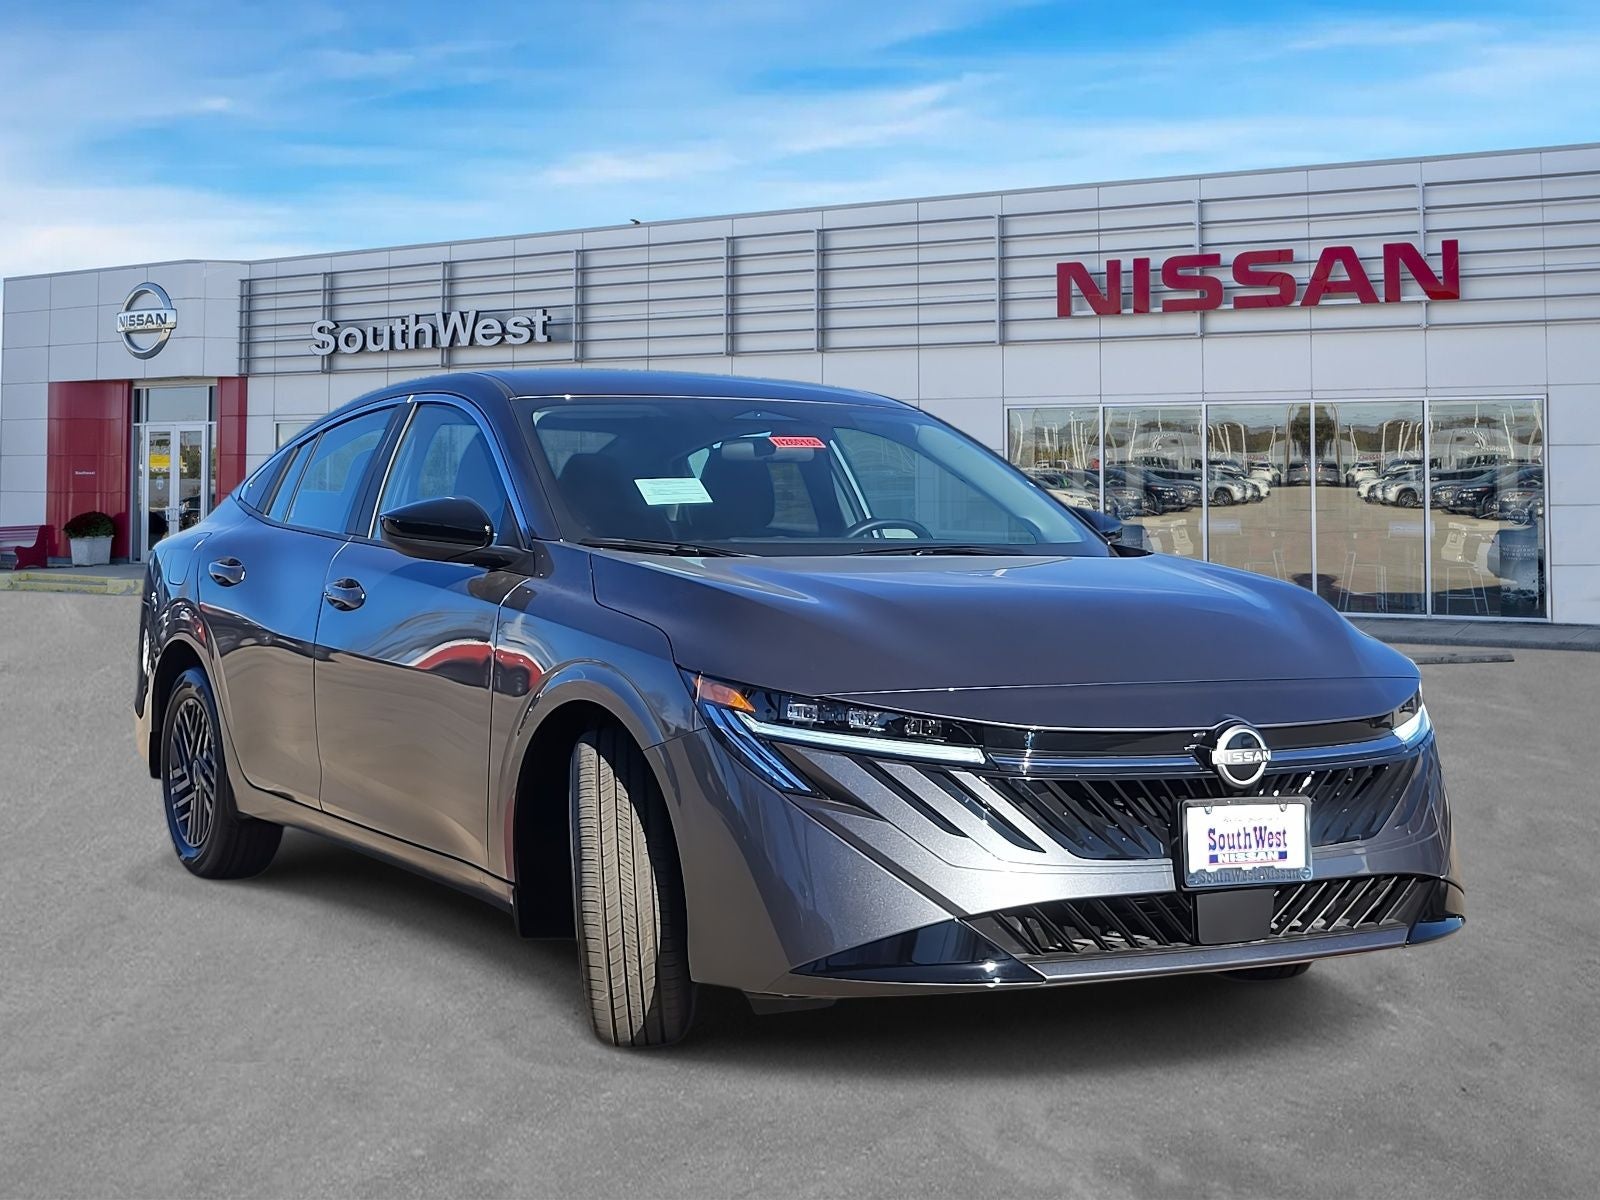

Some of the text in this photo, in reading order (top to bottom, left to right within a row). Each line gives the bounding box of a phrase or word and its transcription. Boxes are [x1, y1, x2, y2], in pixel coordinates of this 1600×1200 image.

[1057, 239, 1460, 317] NISSAN
[119, 312, 168, 328] NISSAN
[309, 307, 551, 356] SouthWest
[1213, 751, 1271, 763] NISSAN
[1208, 826, 1287, 851] SouthWest
[1220, 850, 1277, 863] NISSAN
